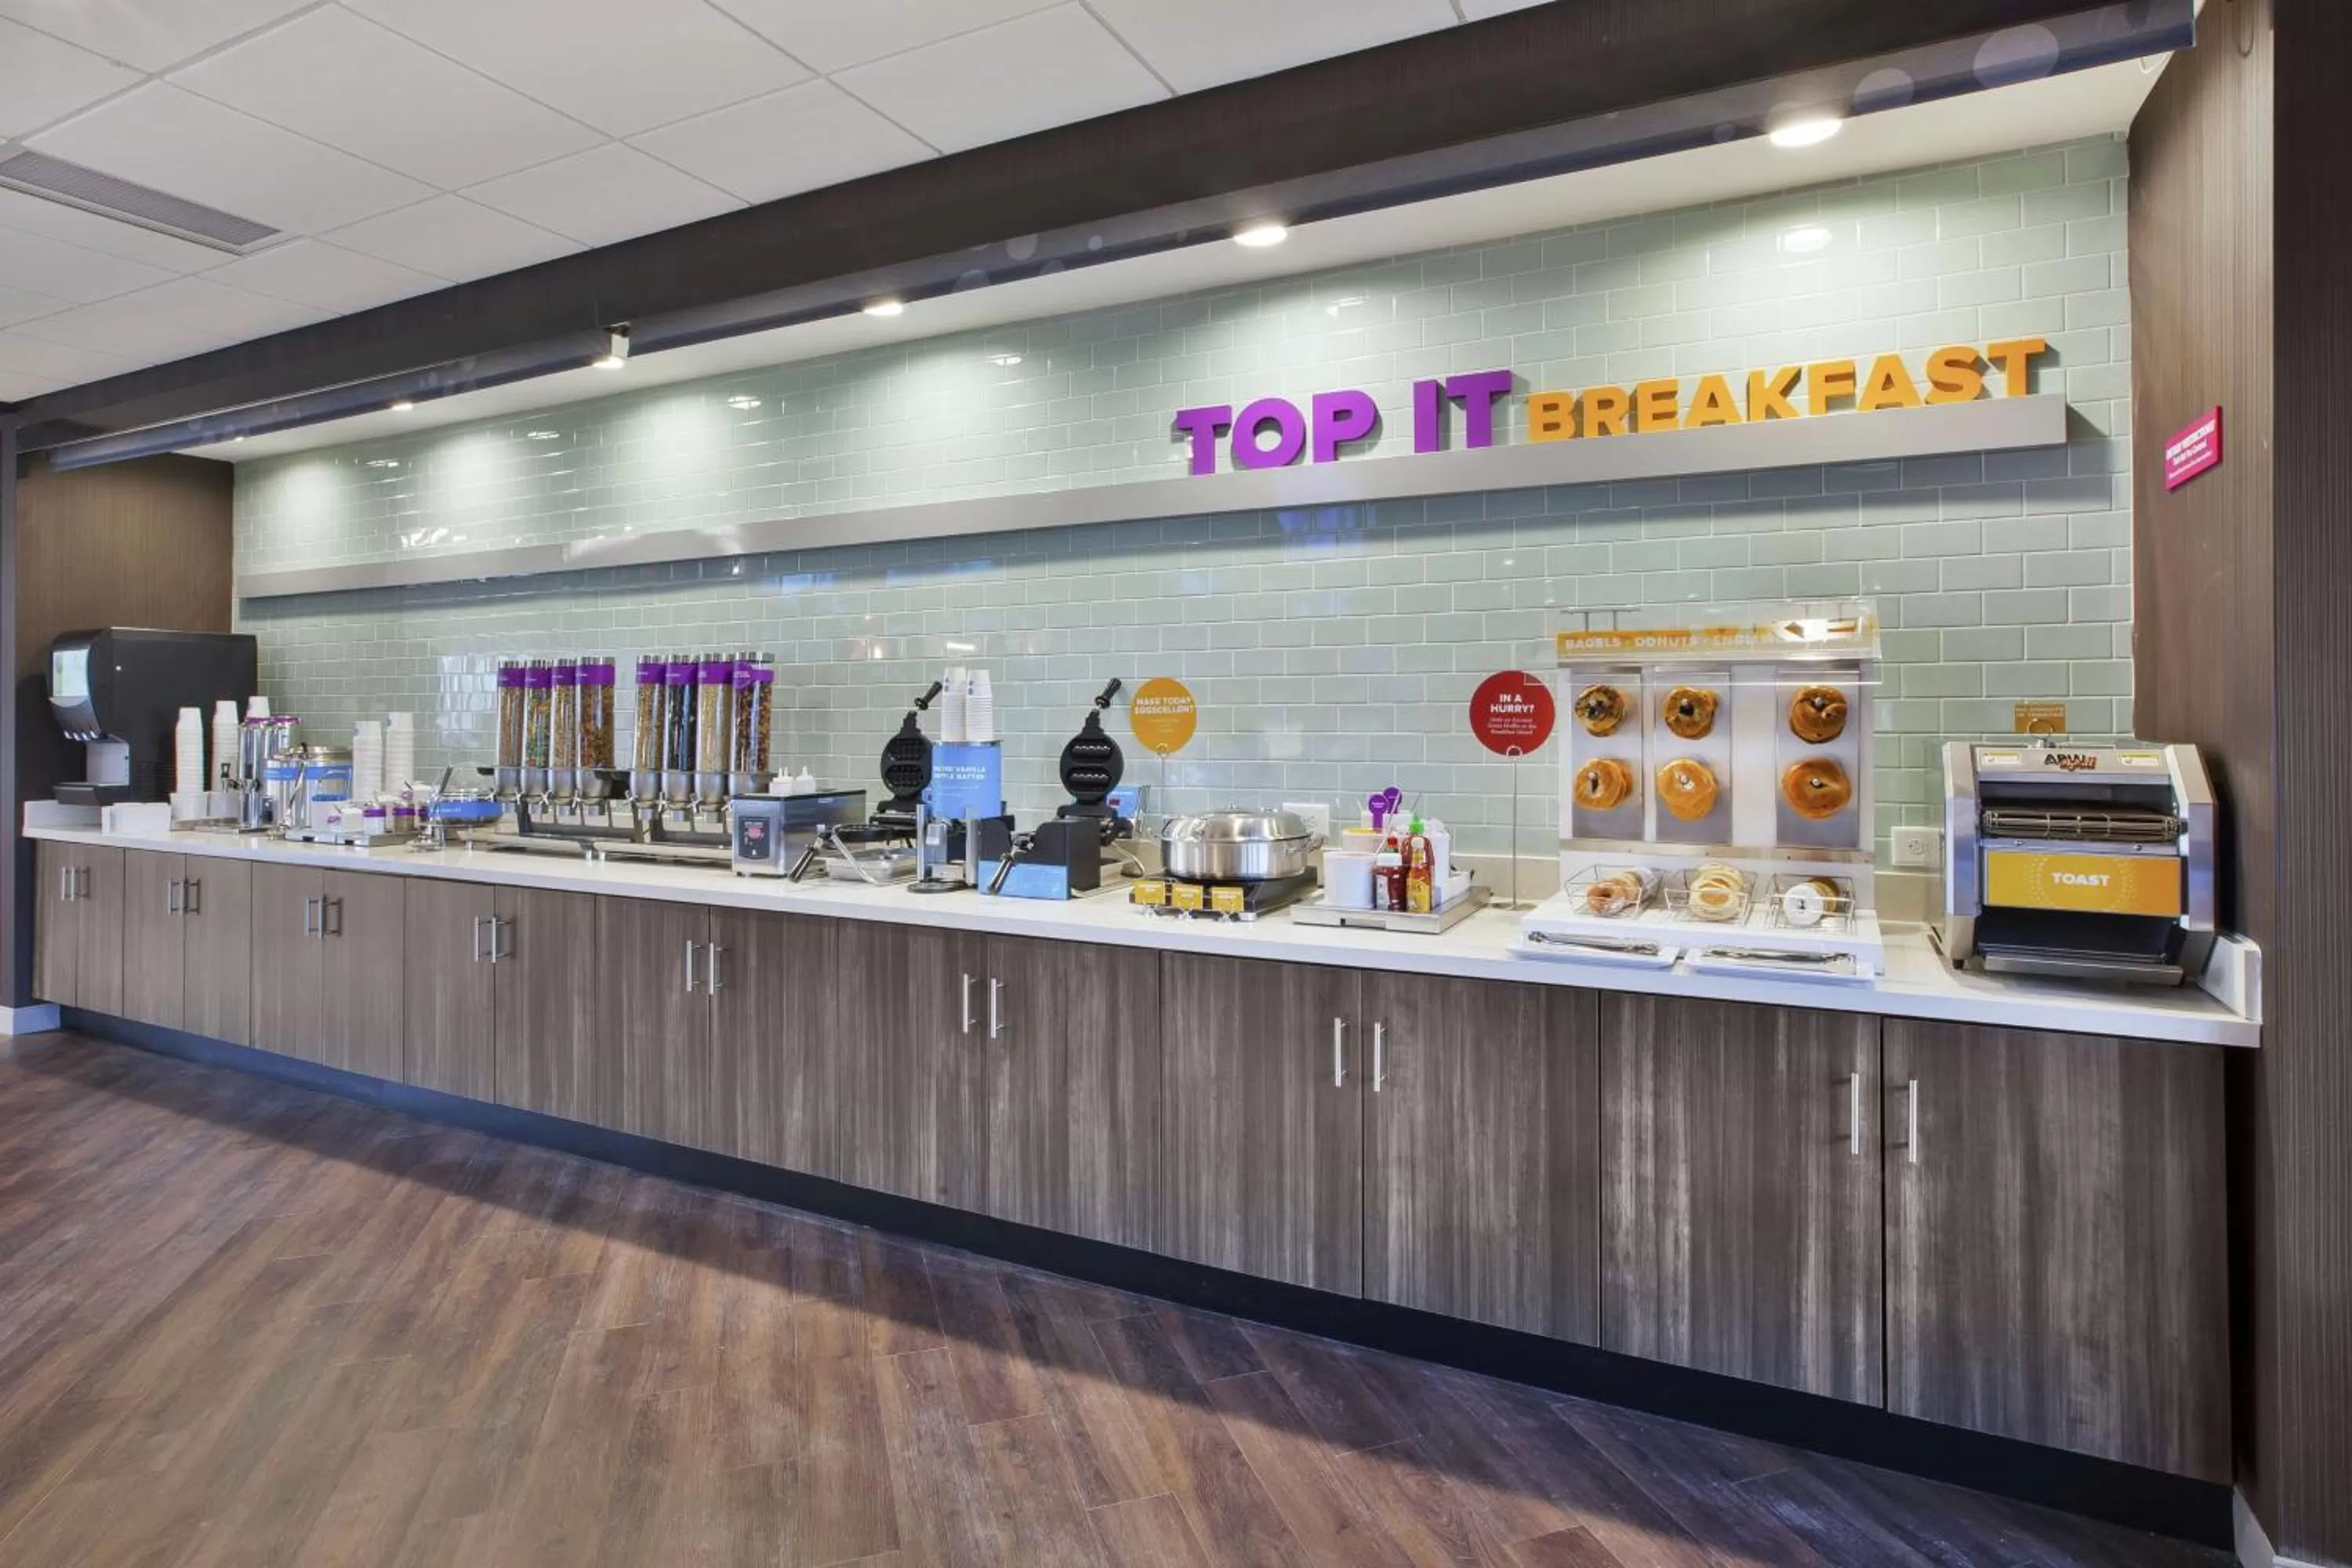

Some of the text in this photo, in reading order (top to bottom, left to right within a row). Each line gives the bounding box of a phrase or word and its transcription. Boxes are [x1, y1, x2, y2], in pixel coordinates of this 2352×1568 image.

[1174, 339, 2046, 477] TOP IT BREAKFAST
[1566, 637, 1622, 651] BAGELS
[1499, 694, 1523, 702] IN A
[1490, 704, 1534, 713] HURRY?
[2051, 873, 2111, 887] TOAST
